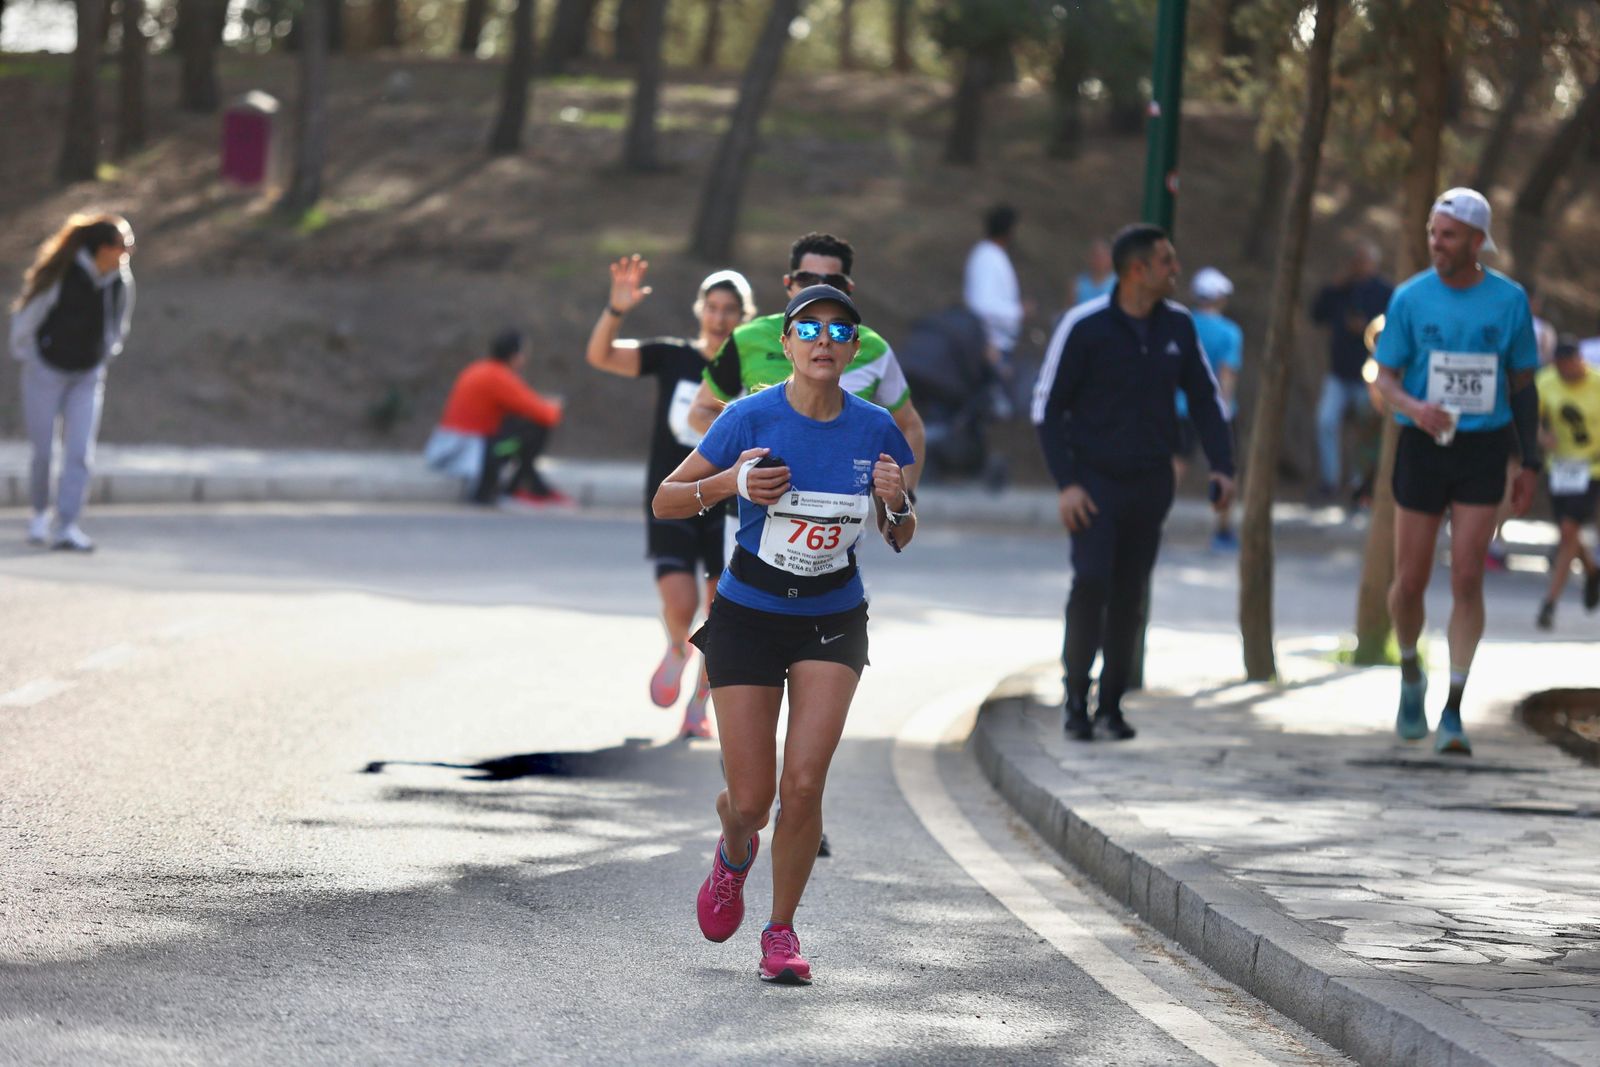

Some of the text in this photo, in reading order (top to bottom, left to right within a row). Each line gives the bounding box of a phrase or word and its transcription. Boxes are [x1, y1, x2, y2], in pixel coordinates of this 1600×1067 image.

[787, 519, 842, 551] 763
[787, 562, 804, 571] PEÑA
[799, 558, 812, 566] MINI
